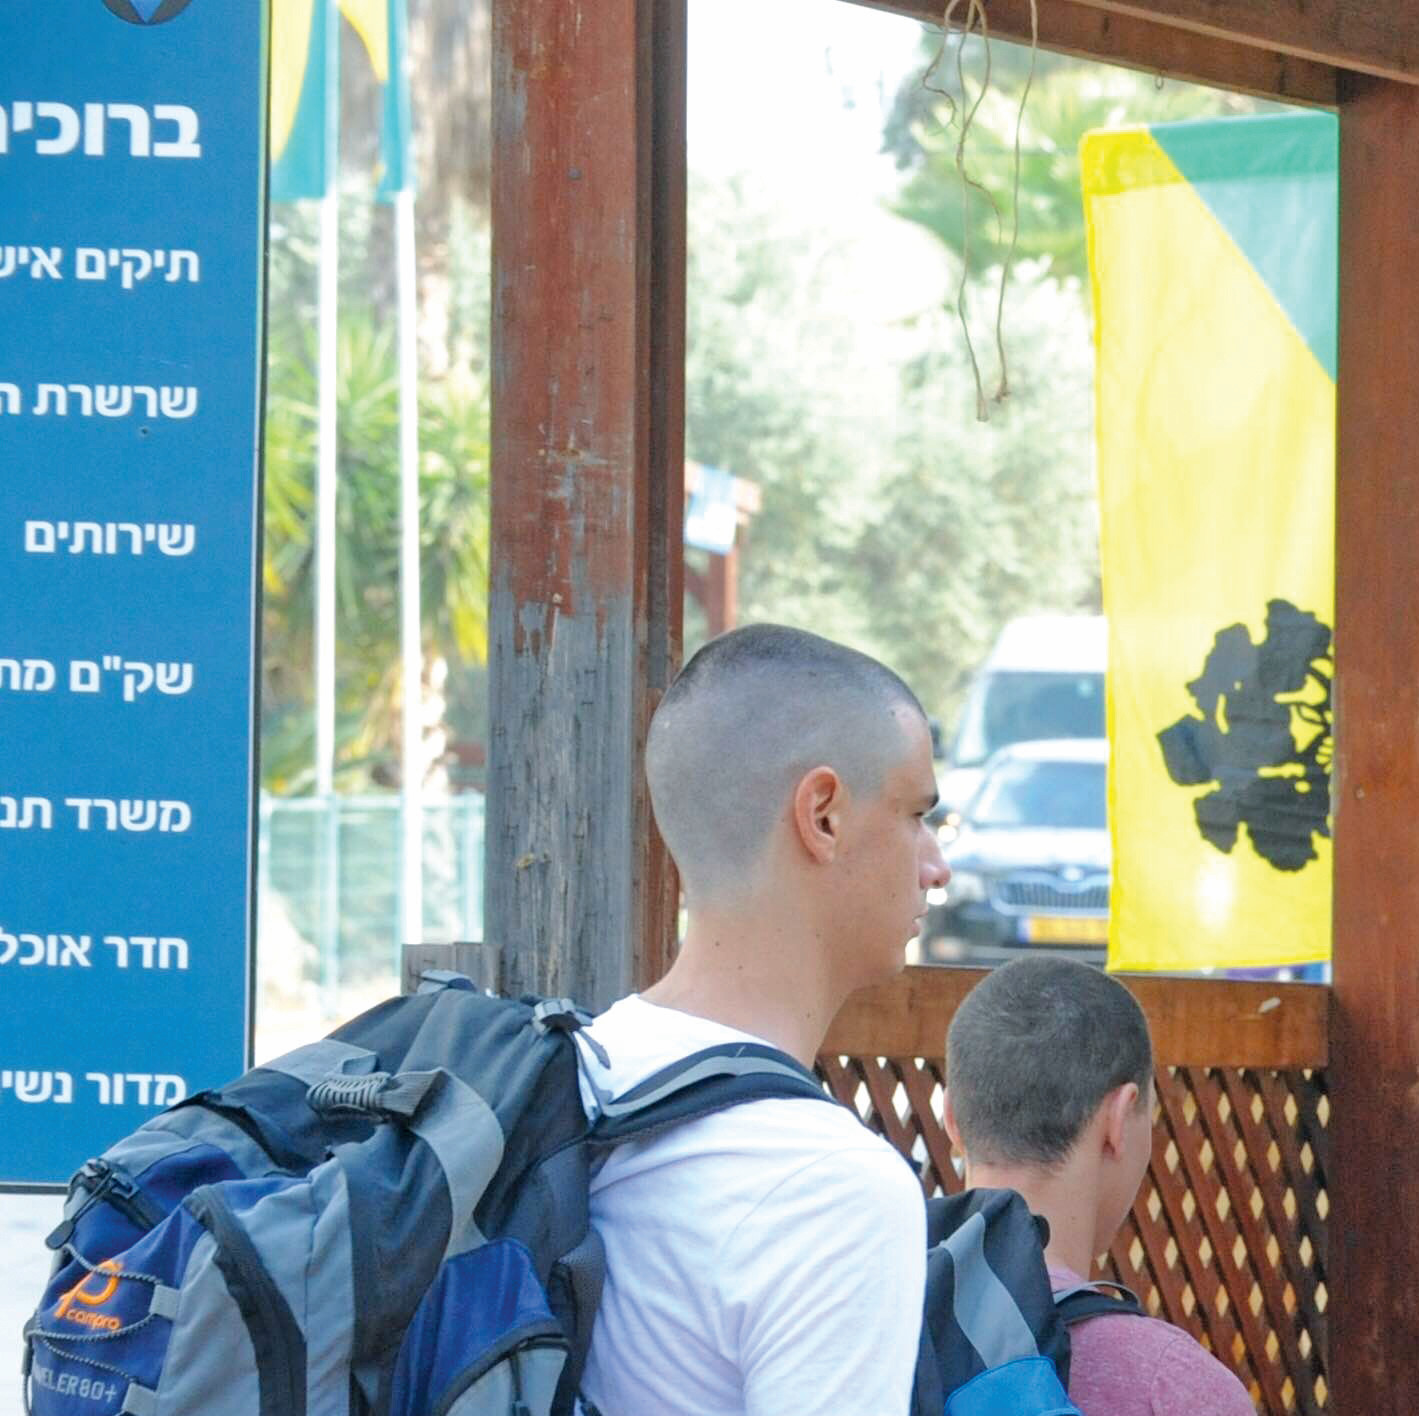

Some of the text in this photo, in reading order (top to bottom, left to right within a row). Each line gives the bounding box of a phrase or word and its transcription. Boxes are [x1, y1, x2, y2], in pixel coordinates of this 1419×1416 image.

[0, 101, 201, 158] ברוכי
[76, 247, 199, 289] תיקים
[33, 383, 198, 419] שרשרת
[24, 520, 195, 556] שירותים
[70, 655, 193, 702] שק"ם
[65, 798, 191, 832] משרד
[104, 936, 188, 969] חדר
[1, 1070, 186, 1105] מדור נשי
